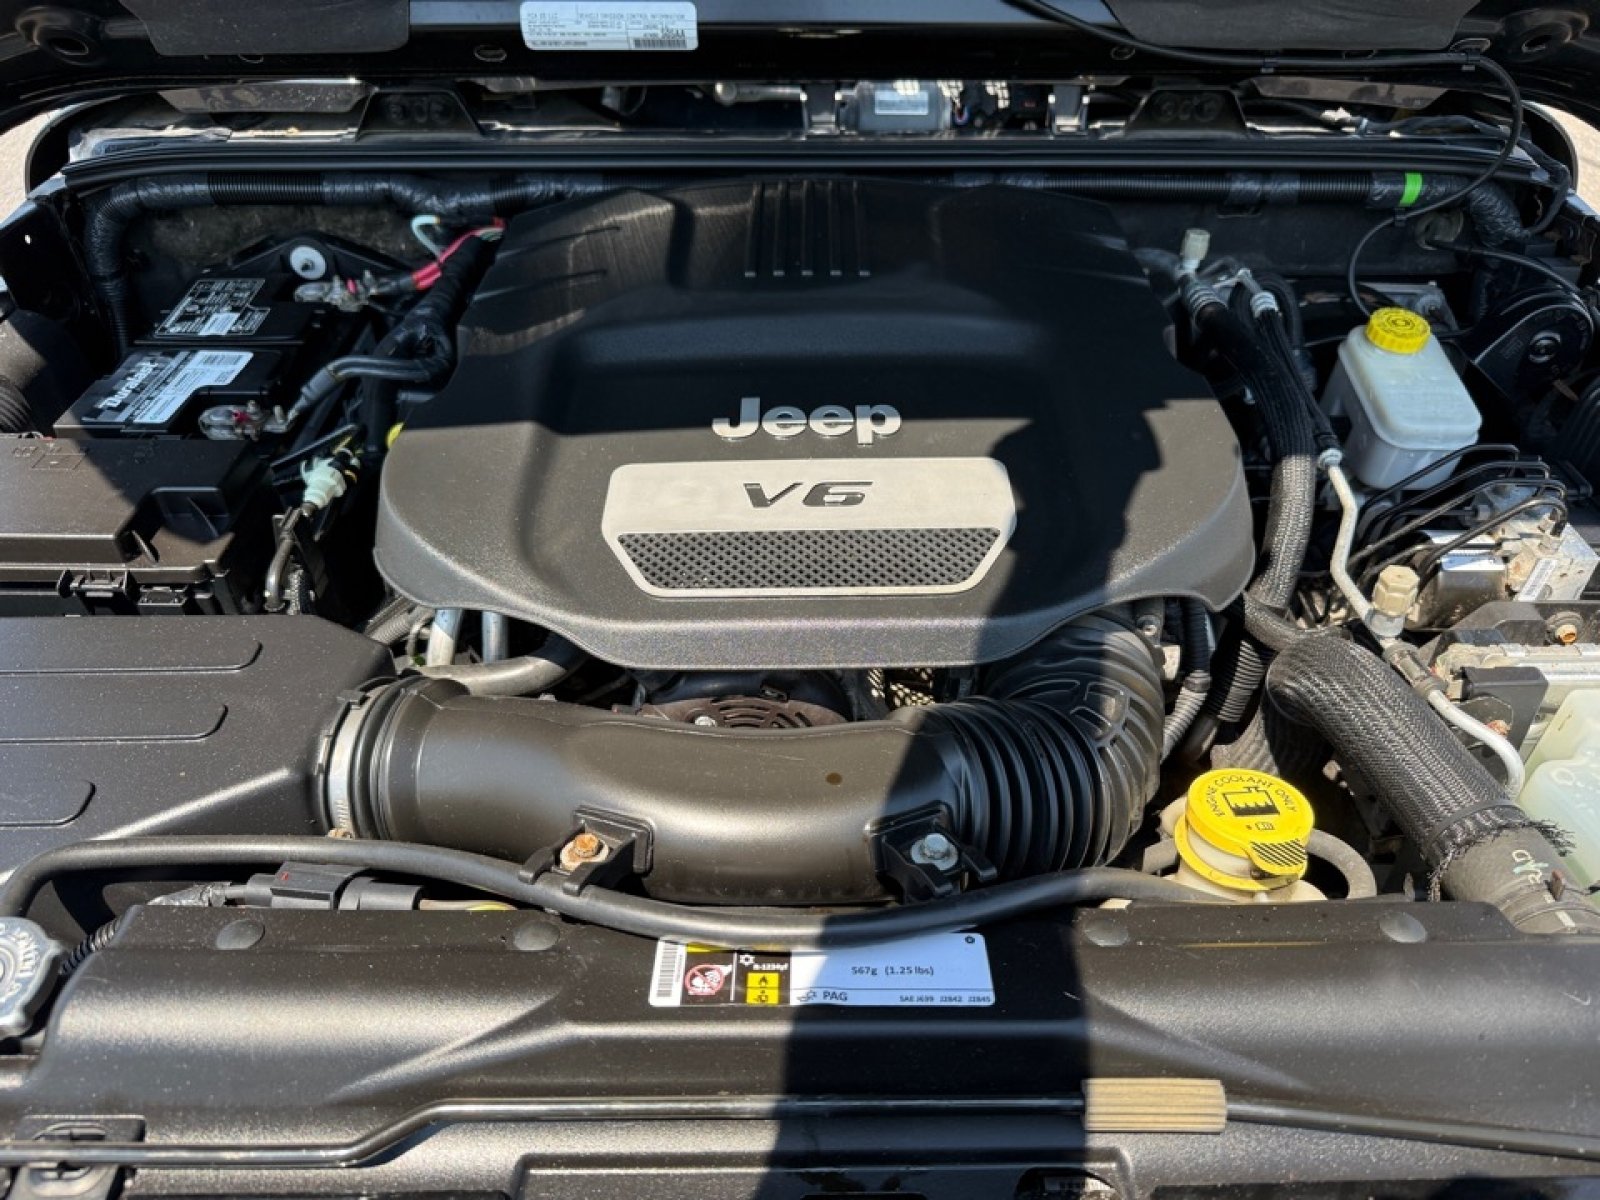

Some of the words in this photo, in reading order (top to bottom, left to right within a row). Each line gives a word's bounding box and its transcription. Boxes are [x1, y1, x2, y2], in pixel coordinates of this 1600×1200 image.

[712, 397, 901, 446] Jeep
[743, 480, 874, 508] V6
[1215, 775, 1273, 788] COOLANT
[1206, 785, 1225, 816] ENGINE
[1275, 789, 1297, 812] ONLY
[851, 966, 878, 976] 567g
[884, 966, 913, 976] (1.25
[914, 966, 935, 976] lbs)
[823, 991, 848, 1002] PAG
